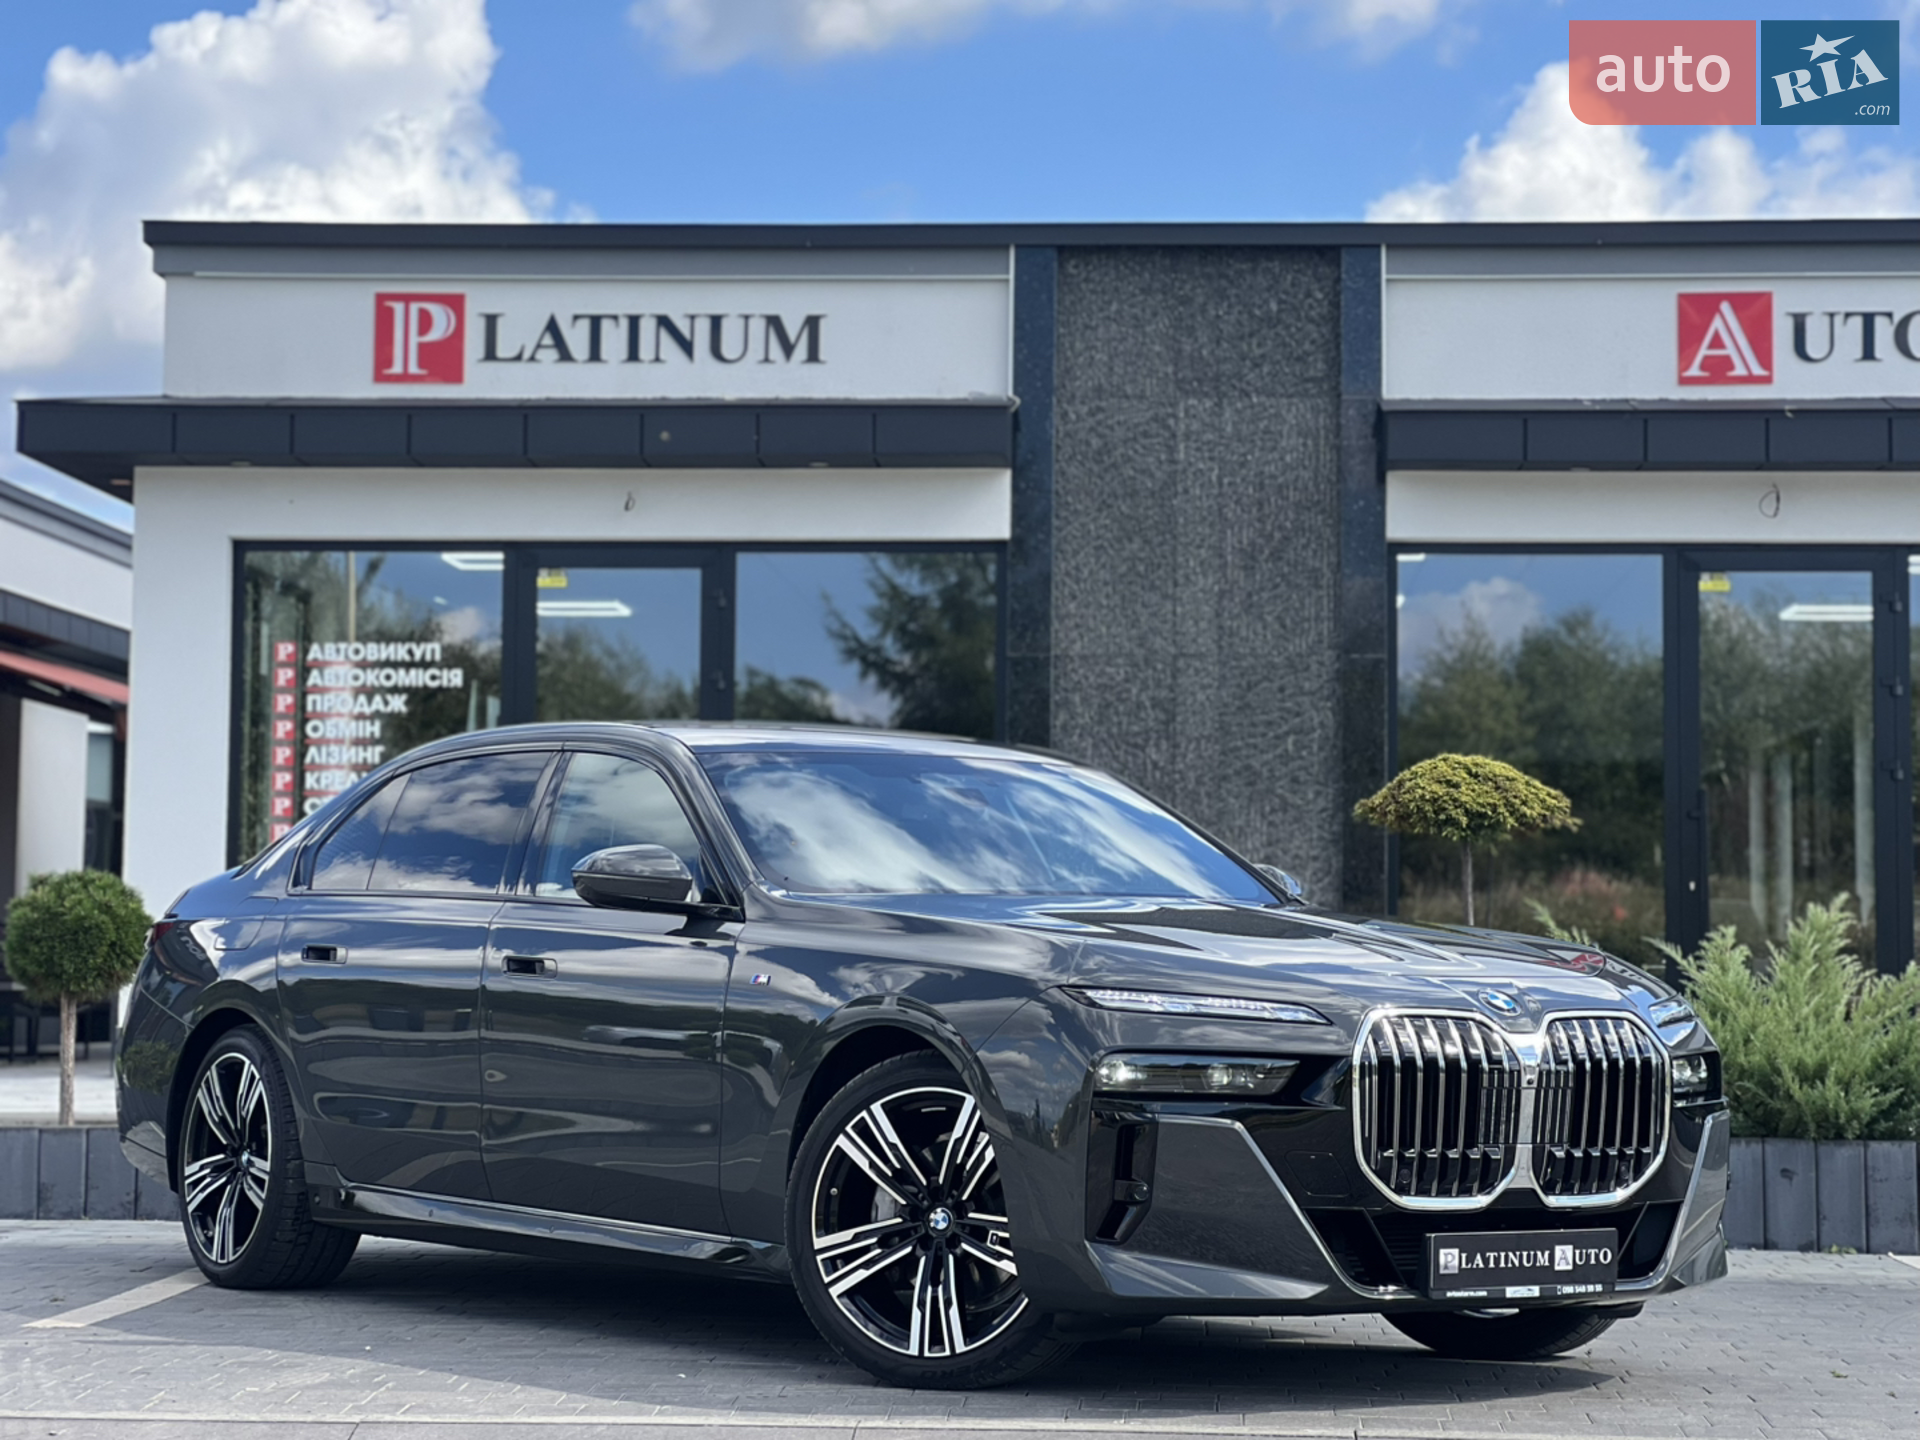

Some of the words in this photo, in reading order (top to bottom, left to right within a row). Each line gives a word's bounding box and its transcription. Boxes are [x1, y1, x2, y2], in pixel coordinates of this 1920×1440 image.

[381, 300, 828, 375] PLATINUM
[306, 642, 442, 662] АВТОВИКУП
[306, 668, 464, 688] АВТОКОМІСІЯ
[306, 693, 409, 714] ПРОДАЖ
[305, 719, 381, 739] ОБМІН
[304, 745, 386, 764] ЛІЗИНГ
[1441, 1249, 1550, 1272] PLATINUM
[1555, 1246, 1613, 1269] AUTO
